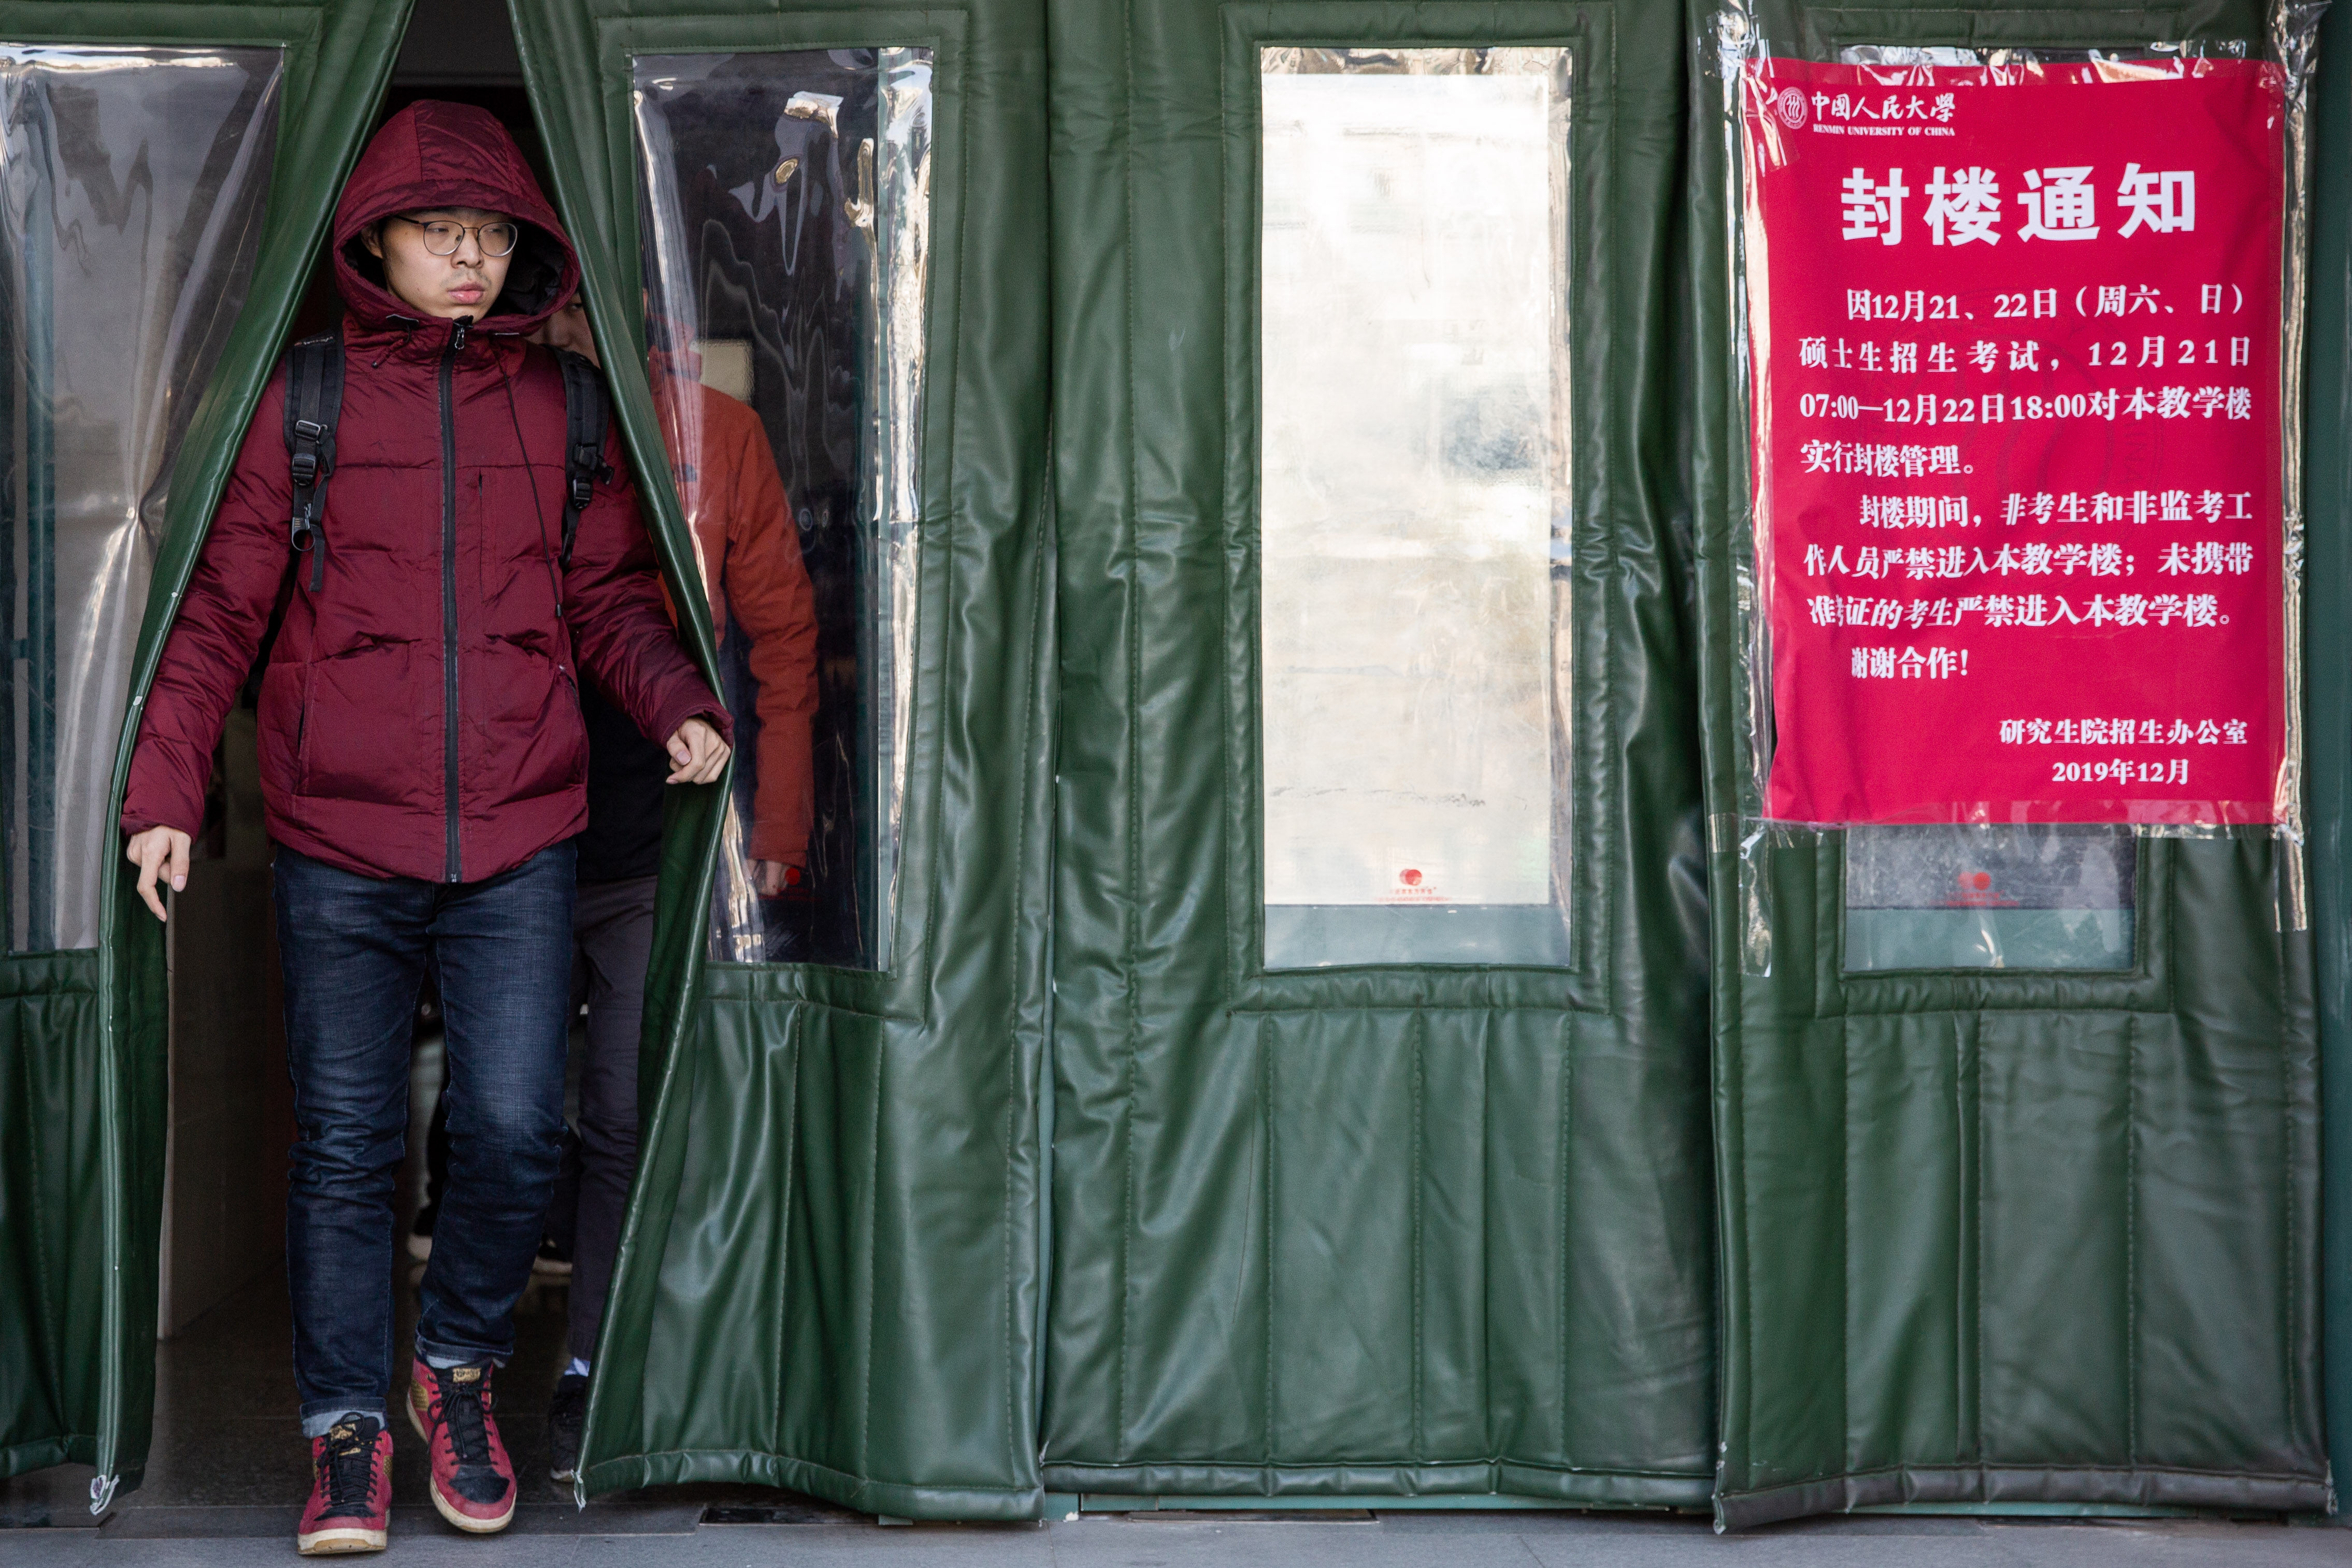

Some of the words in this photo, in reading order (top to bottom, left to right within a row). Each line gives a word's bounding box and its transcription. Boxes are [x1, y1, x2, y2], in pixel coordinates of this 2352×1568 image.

[1813, 124, 1844, 134] RENMIN
[1848, 126, 1904, 135] UNIVERSITY
[1908, 127, 1921, 135] OF
[1925, 127, 1955, 136] CHINA
[1841, 163, 2195, 246] 封楼通知
[1801, 439, 1973, 477] 实行封楼管理。
[1999, 718, 2247, 744] 研究生院招生办公室
[2052, 758, 2188, 785] 2019年12月
